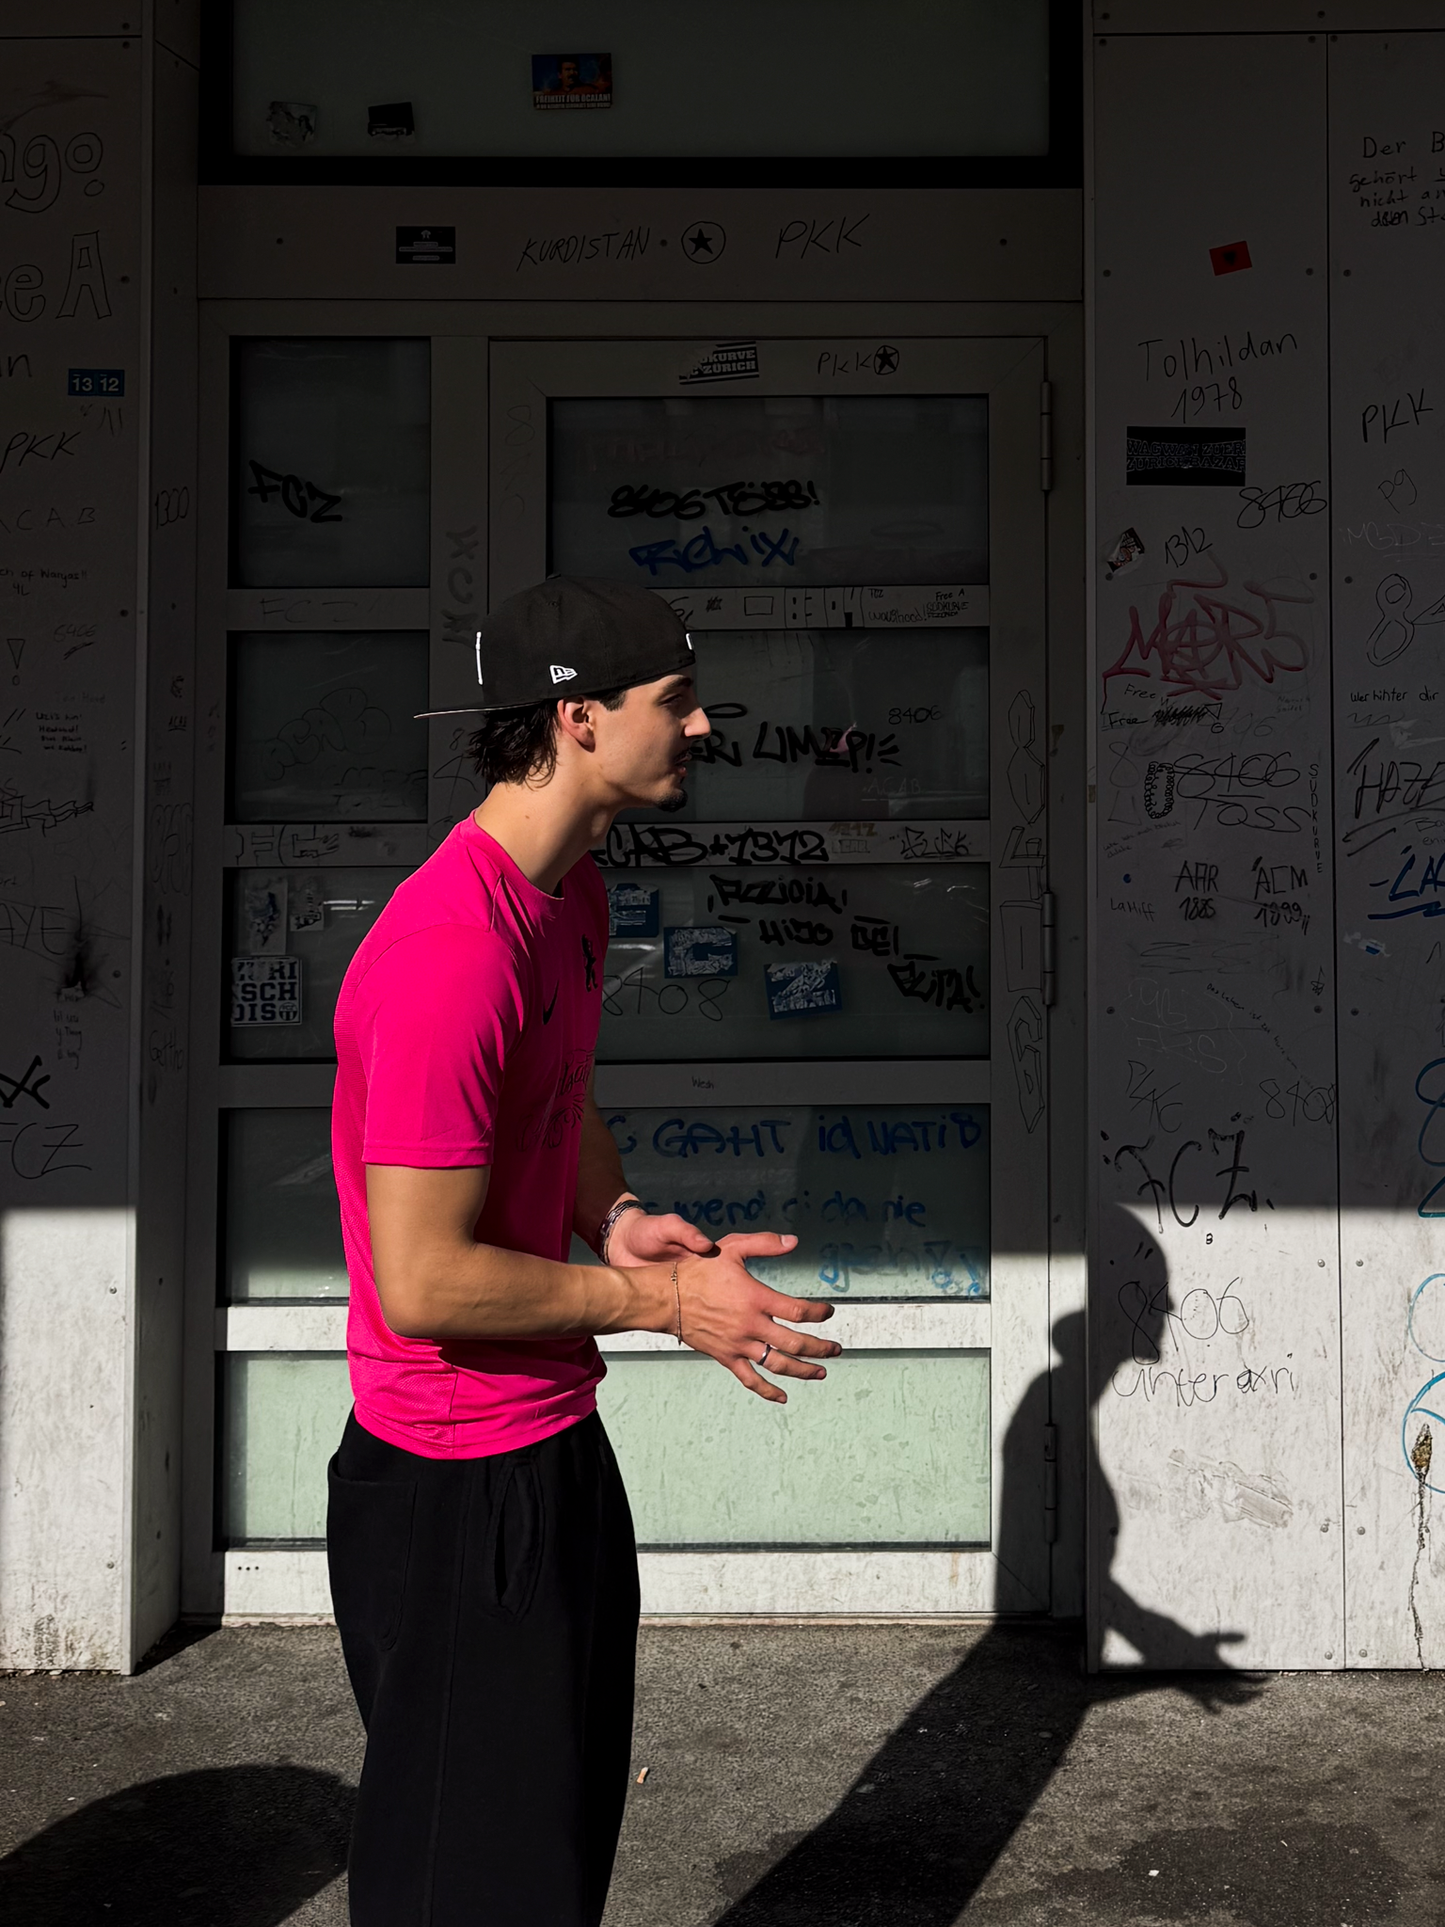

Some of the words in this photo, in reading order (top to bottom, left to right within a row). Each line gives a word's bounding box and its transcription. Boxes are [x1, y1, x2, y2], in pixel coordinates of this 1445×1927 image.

[1362, 136, 1407, 159] Der
[1360, 189, 1410, 208] nicht
[516, 226, 651, 272] KURDISTAN
[774, 213, 871, 259] PKK
[702, 360, 757, 375] ZÜRICH
[1137, 331, 1298, 382] Tolhildan
[72, 377, 93, 392] 13
[100, 377, 120, 392] 12
[1170, 376, 1243, 424] 1978
[1361, 388, 1434, 444] PKK
[0, 431, 82, 475] PKK
[1418, 685, 1439, 702] dir
[888, 705, 943, 725] 8406
[236, 982, 298, 1002] SCH
[652, 1116, 792, 1159] GAHT
